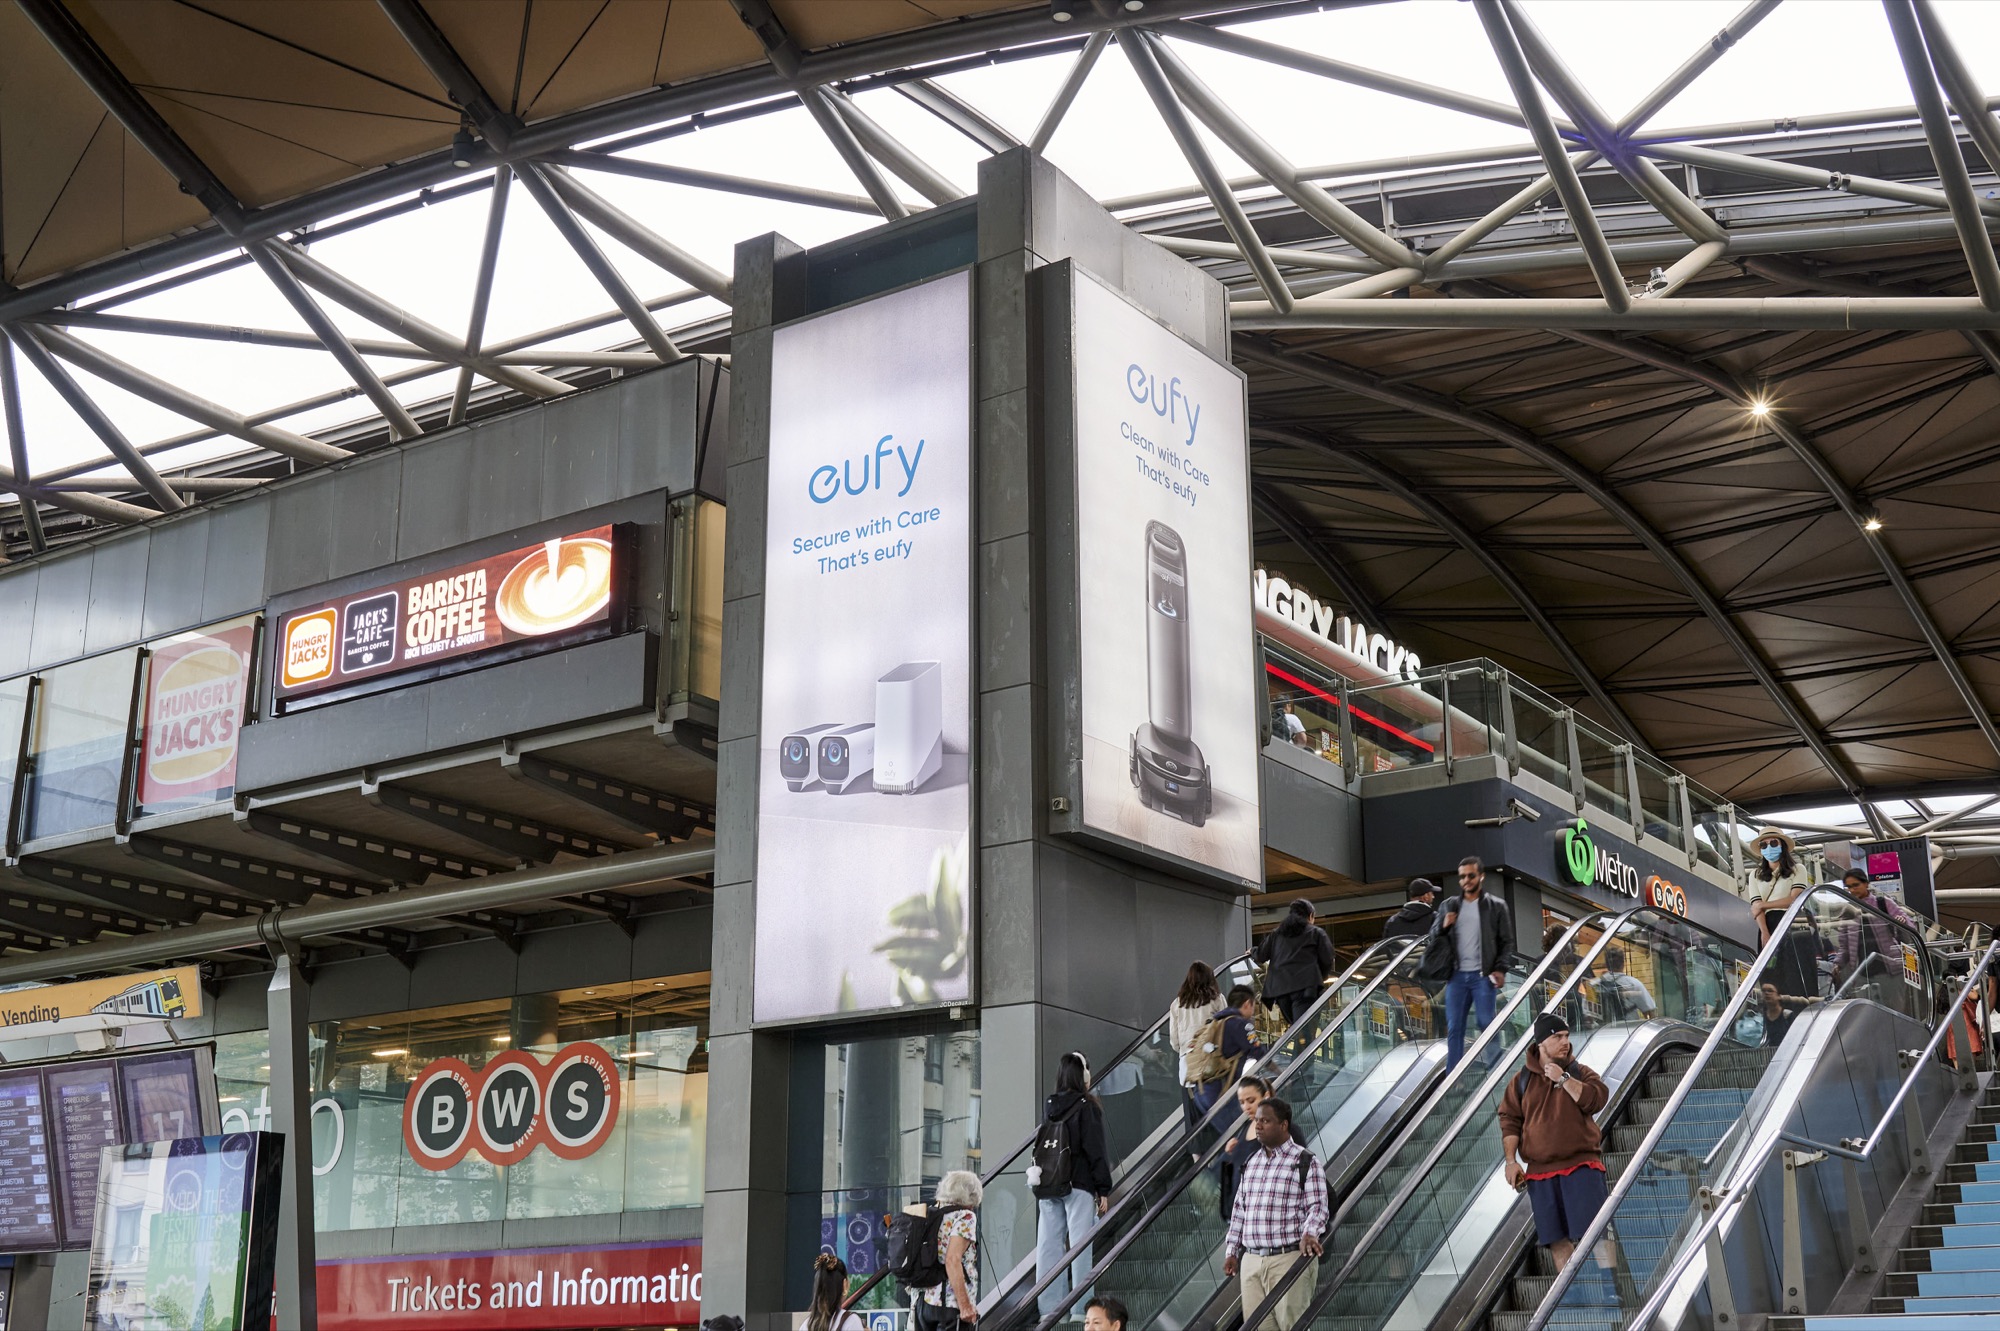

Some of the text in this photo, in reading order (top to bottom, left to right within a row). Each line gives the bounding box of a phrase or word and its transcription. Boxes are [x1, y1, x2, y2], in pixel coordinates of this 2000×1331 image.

[1127, 364, 1200, 446] eufy
[808, 434, 925, 504] eufy
[1121, 421, 1210, 486] Clean with Care
[1136, 455, 1197, 507] That's eufy
[793, 508, 940, 555] Secure with Care
[818, 539, 913, 574] That's eufy
[407, 569, 487, 615] BARISTA
[353, 607, 388, 630] JACK'S
[356, 625, 383, 644] CAFE
[406, 596, 487, 647] COFFEE
[290, 645, 327, 665] JACK'S
[292, 633, 328, 651] HUNGRY
[348, 640, 390, 656] BARISTA COFFEE
[404, 646, 420, 660] RICH
[421, 639, 450, 655] VELVETY
[456, 630, 485, 647] SMOOTH
[1337, 616, 1421, 690] JACK'S
[158, 680, 238, 721] HUNGRY
[155, 708, 235, 757] JACK'S
[1594, 845, 1639, 898] Metro
[1, 1004, 60, 1026] Vending
[453, 1071, 472, 1099] BEER
[583, 1055, 611, 1093] SPIRITS
[515, 1118, 539, 1149] WINE
[205, 1187, 226, 1214] THE
[163, 1215, 222, 1244] FESTIVITIES
[388, 1275, 482, 1313] Tickets
[490, 1270, 543, 1309] and
